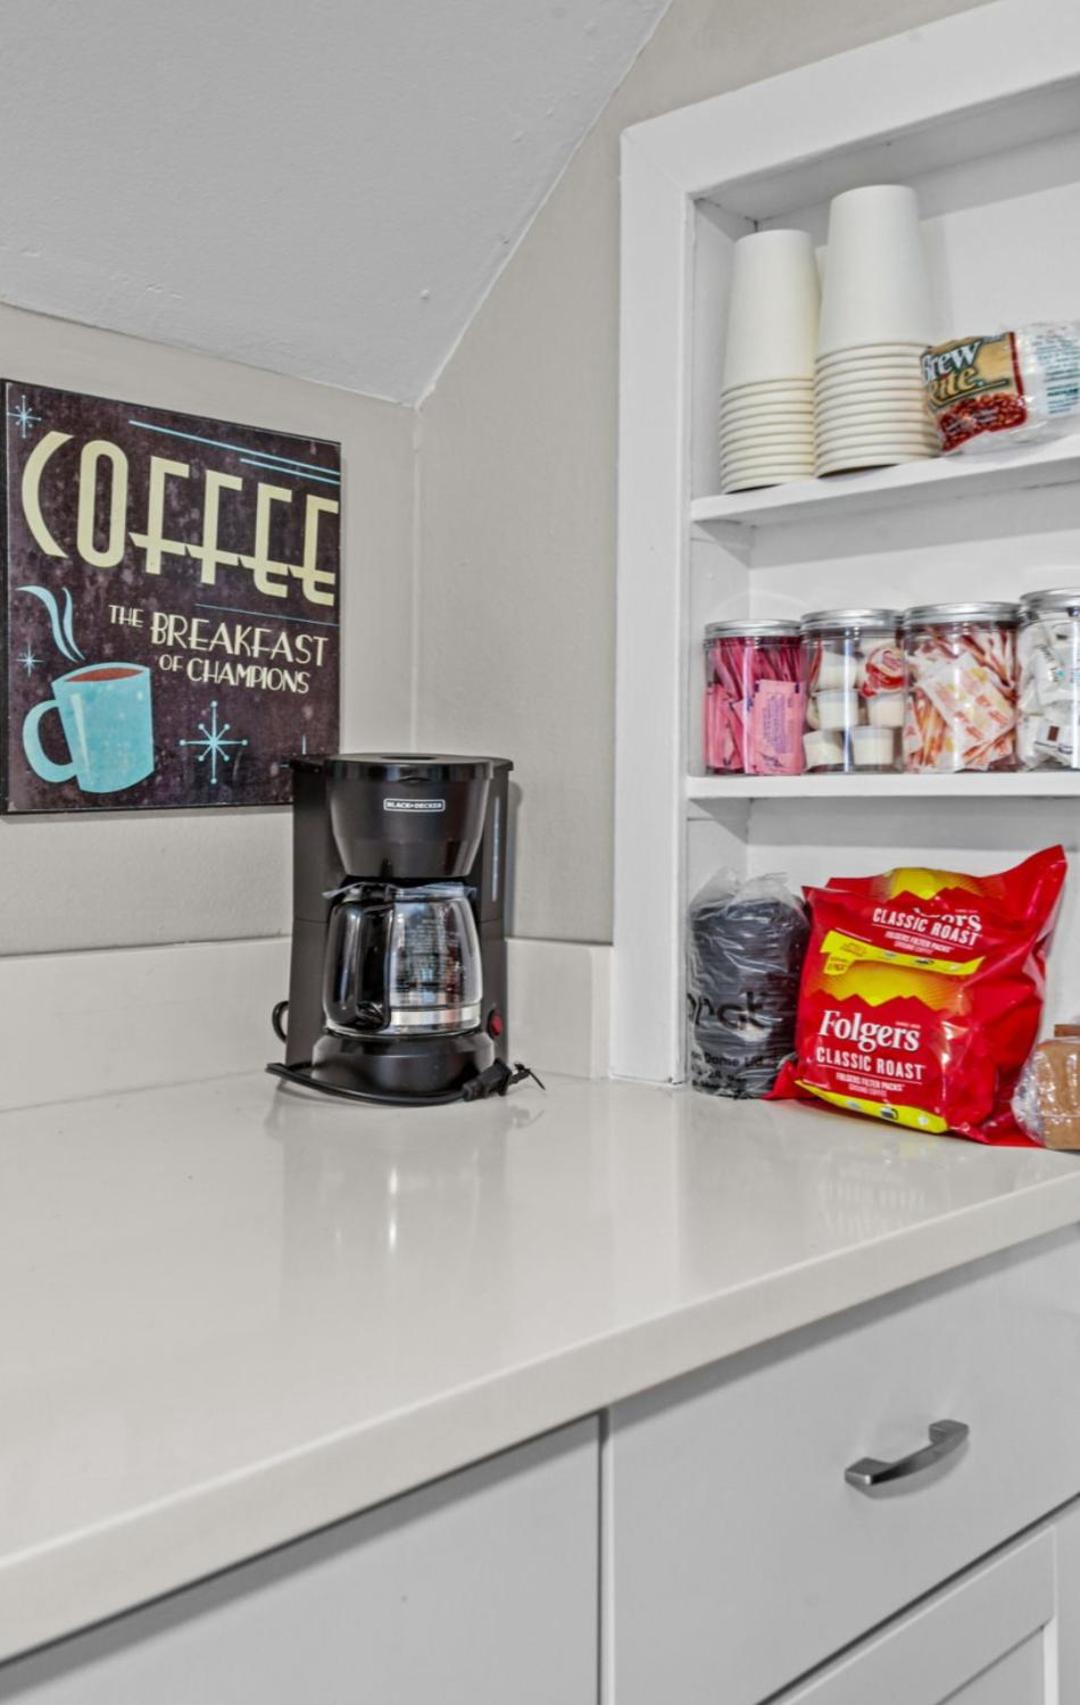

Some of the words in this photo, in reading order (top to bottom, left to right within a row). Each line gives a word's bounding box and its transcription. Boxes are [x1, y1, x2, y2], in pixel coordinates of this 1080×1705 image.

[22, 431, 339, 606] COFFEE
[109, 604, 144, 628] THE
[150, 611, 329, 667] BREAKFAST
[159, 653, 184, 672] OF
[186, 657, 311, 694] CHAMPIONS
[872, 907, 929, 932] CLASSIC
[930, 921, 980, 946] ROAST
[818, 1009, 921, 1052] Folgers
[816, 1046, 872, 1072] CLASSIC
[876, 1057, 925, 1080] ROAST
